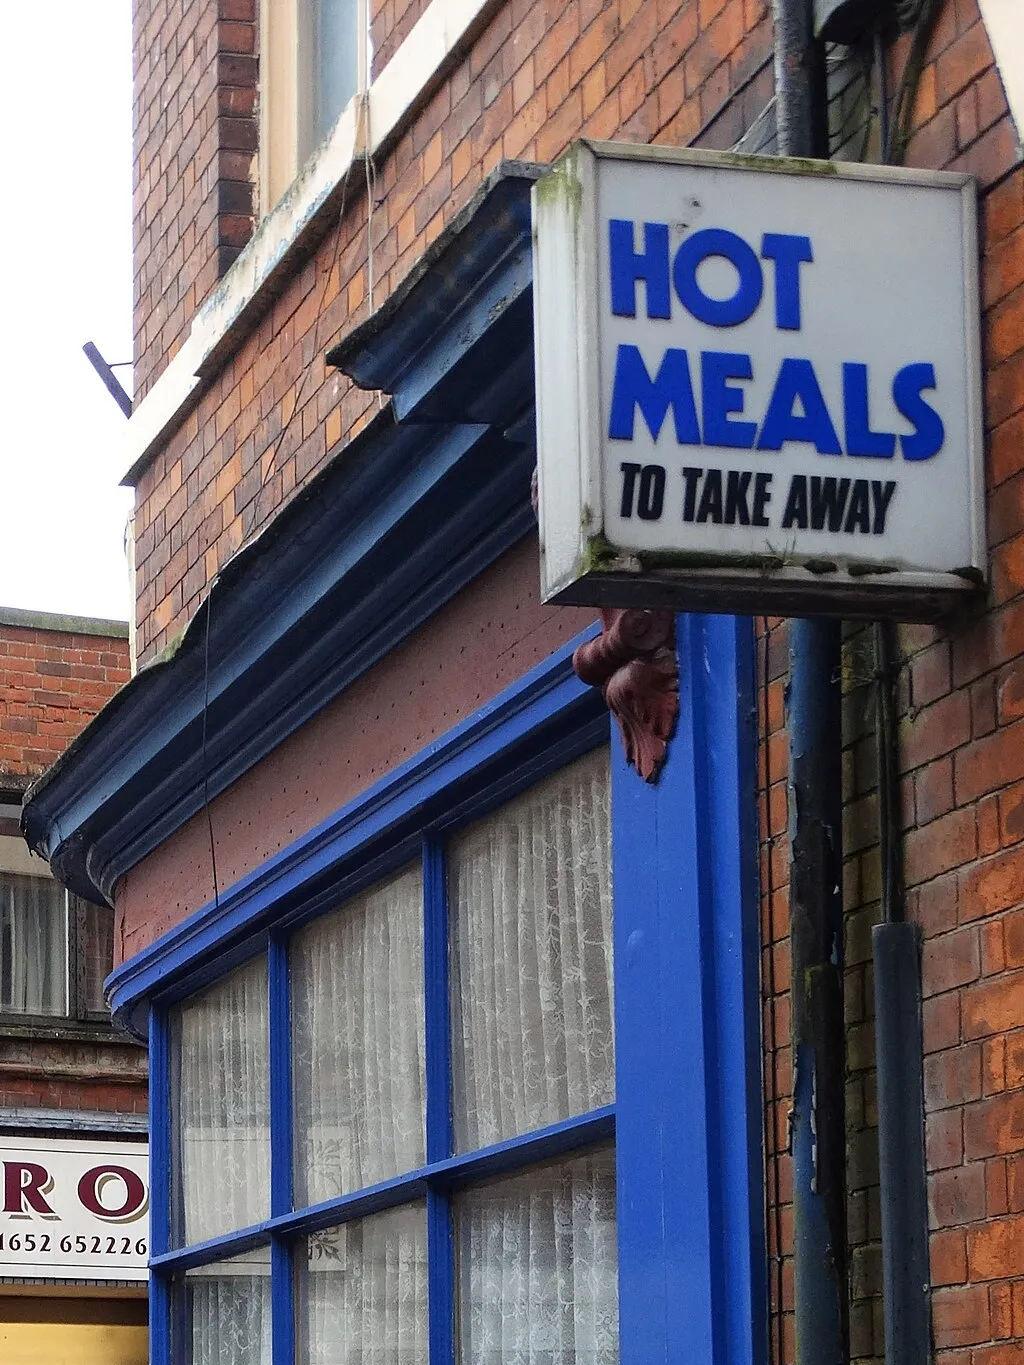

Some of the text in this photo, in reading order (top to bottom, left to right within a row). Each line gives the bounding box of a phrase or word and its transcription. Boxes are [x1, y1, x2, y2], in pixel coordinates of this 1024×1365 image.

[608, 218, 814, 331] HOT
[608, 343, 946, 463] MEALS
[619, 461, 898, 535] TO TAKE AWAY
[59, 1234, 148, 1257] 652226
